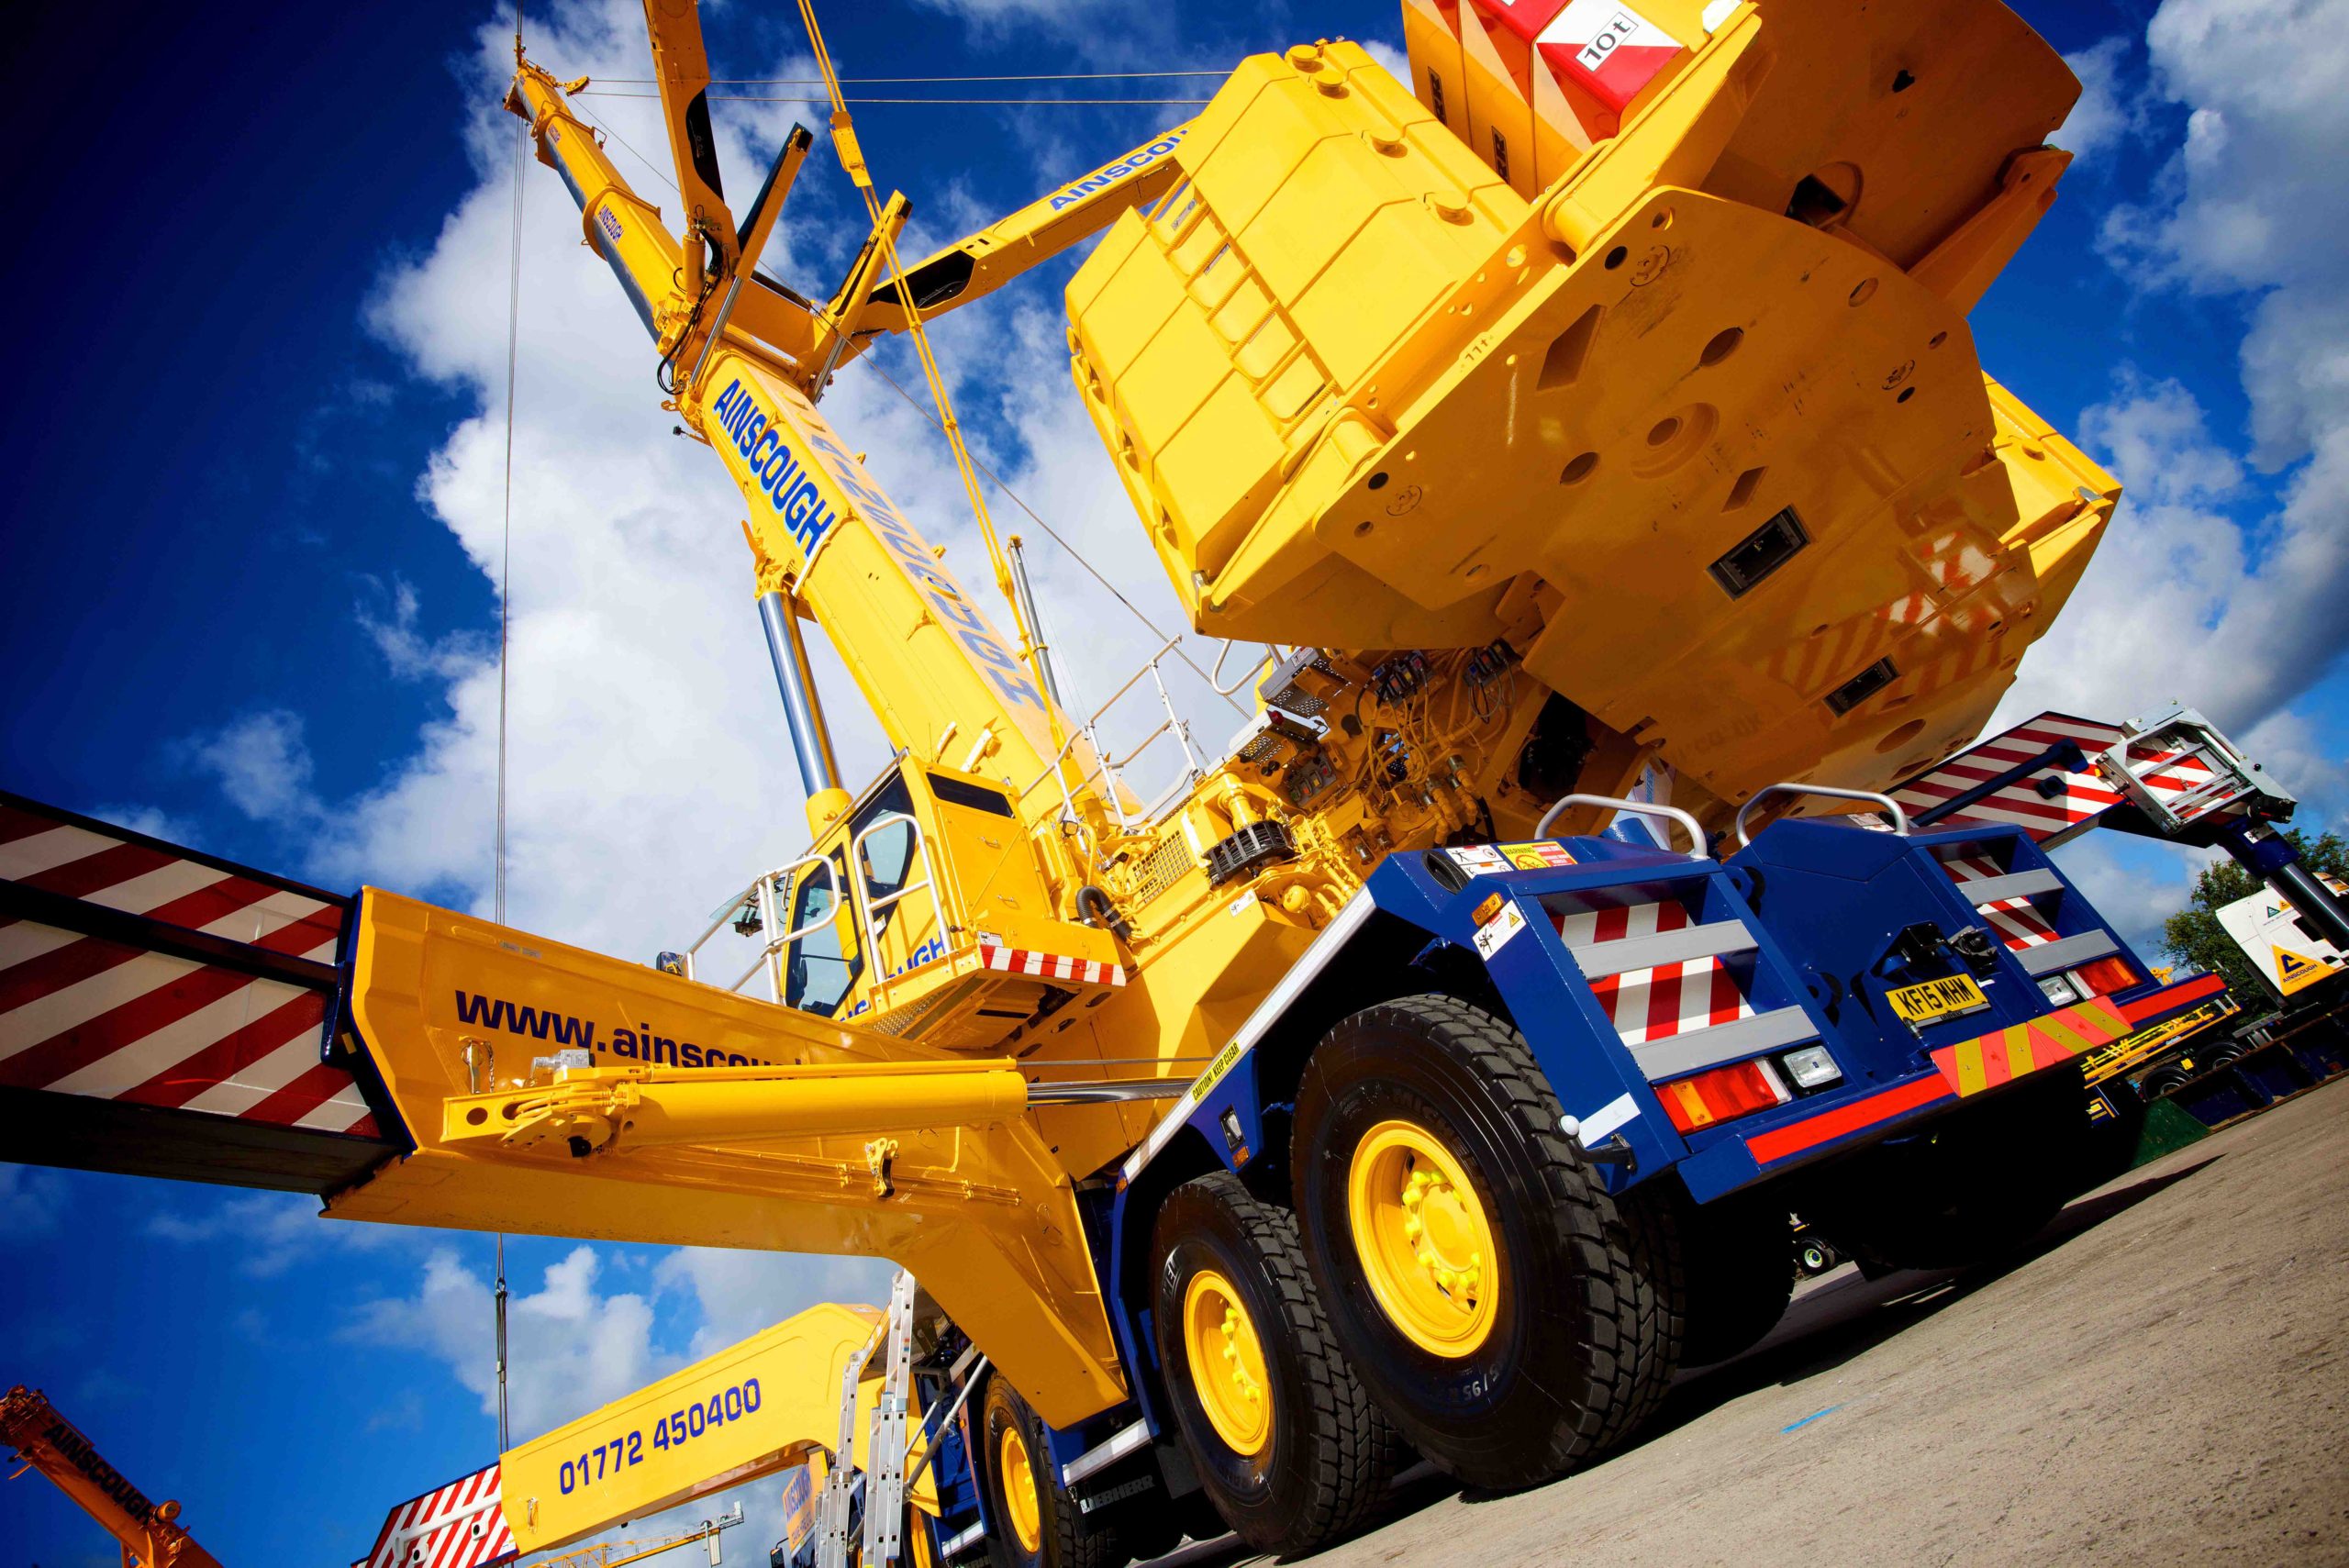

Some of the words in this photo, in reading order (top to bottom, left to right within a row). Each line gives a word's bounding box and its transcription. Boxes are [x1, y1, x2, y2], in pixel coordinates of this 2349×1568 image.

[713, 378, 836, 560] AINSCOUGH
[1896, 984, 1943, 1017] KF15
[1933, 977, 1976, 1006] MHM
[2283, 963, 2318, 984] AINSCOUGH
[1193, 1071, 1214, 1101] CAUTION!
[1212, 1059, 1225, 1078] KEEP
[1223, 1042, 1240, 1065] CLEAR
[560, 1429, 643, 1496] 01772
[653, 1378, 762, 1451] 450400
[43, 1423, 156, 1527] AINSCOUGH
[1079, 1474, 1155, 1514] LIEBHERR
